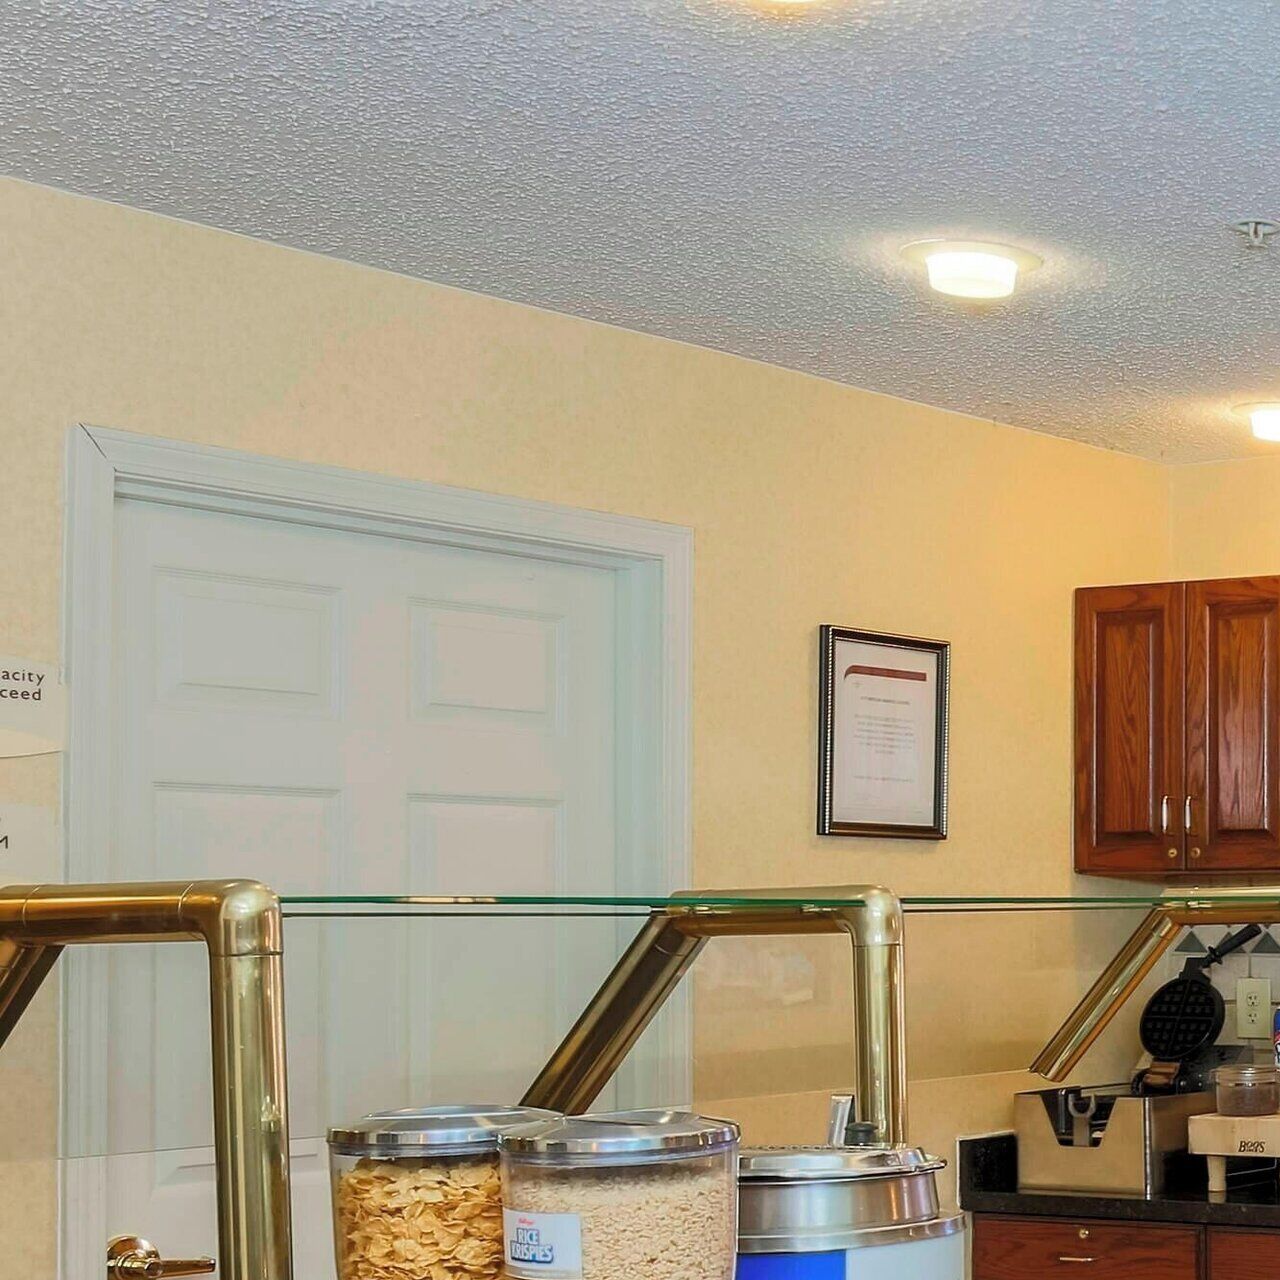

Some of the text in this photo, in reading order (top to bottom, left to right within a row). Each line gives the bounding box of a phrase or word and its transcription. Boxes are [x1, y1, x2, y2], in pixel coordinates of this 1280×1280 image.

[1238, 1141, 1265, 1153] BOOS
[517, 1229, 538, 1245] RICE
[510, 1241, 552, 1261] KRISPIES
